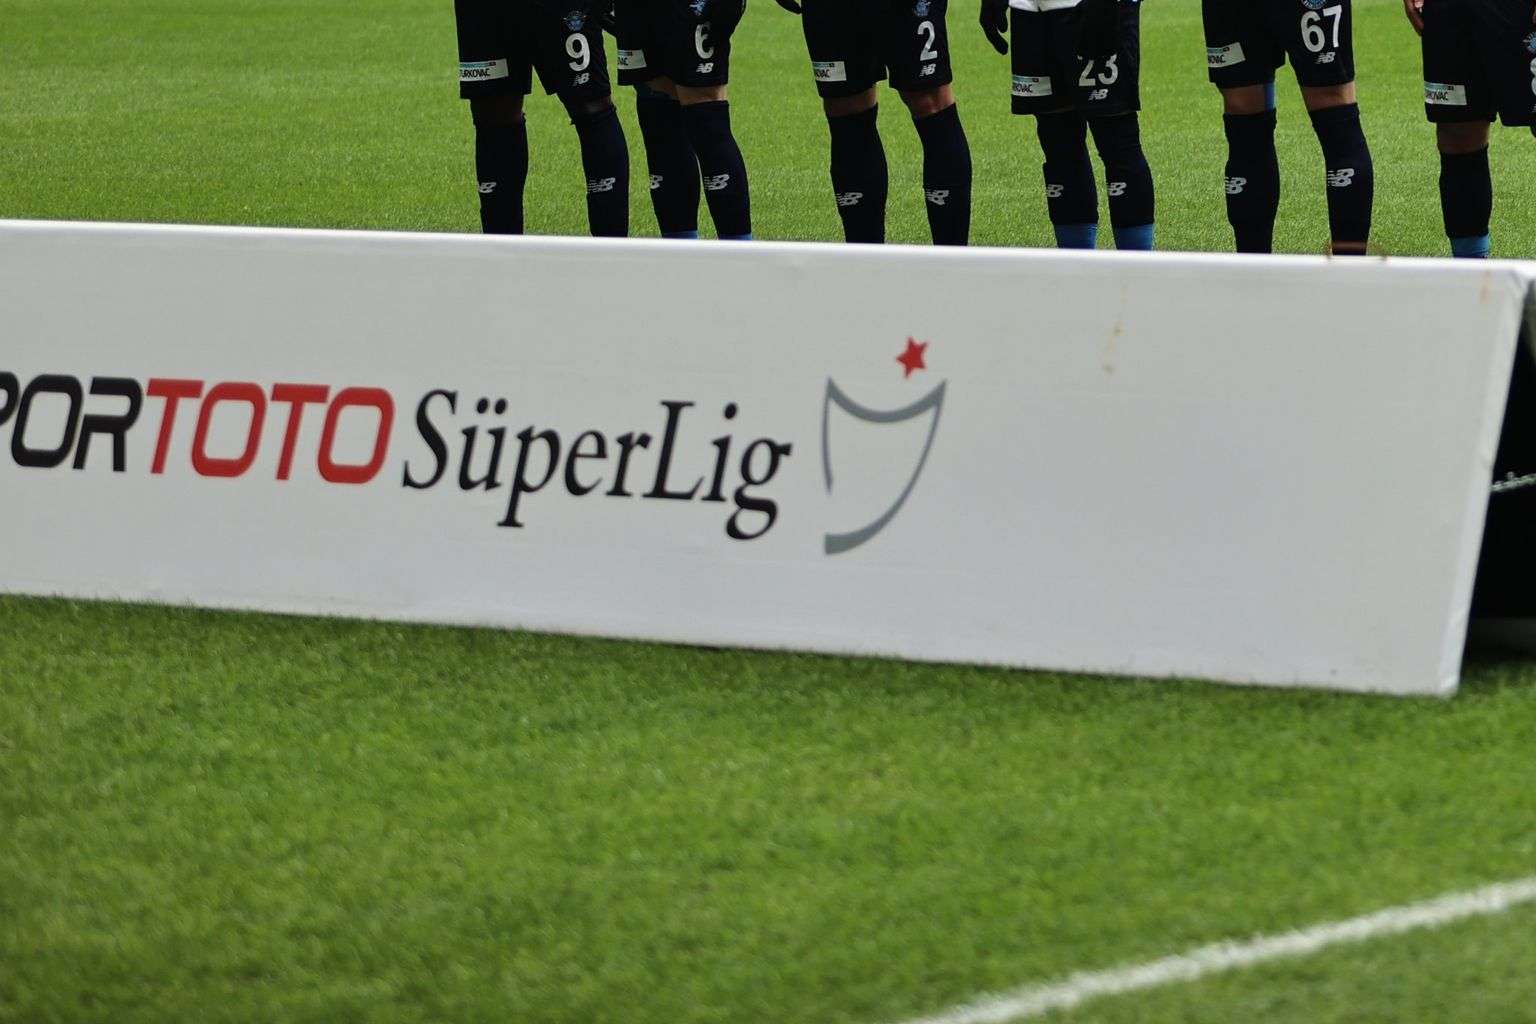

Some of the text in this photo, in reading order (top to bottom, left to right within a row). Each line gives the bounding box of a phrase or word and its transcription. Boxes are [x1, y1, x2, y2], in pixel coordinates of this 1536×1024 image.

[917, 20, 938, 62] 2
[1300, 4, 1342, 52] 67
[566, 33, 591, 72] 9
[1077, 53, 1119, 87] 23
[402, 389, 793, 540] SüperLig
